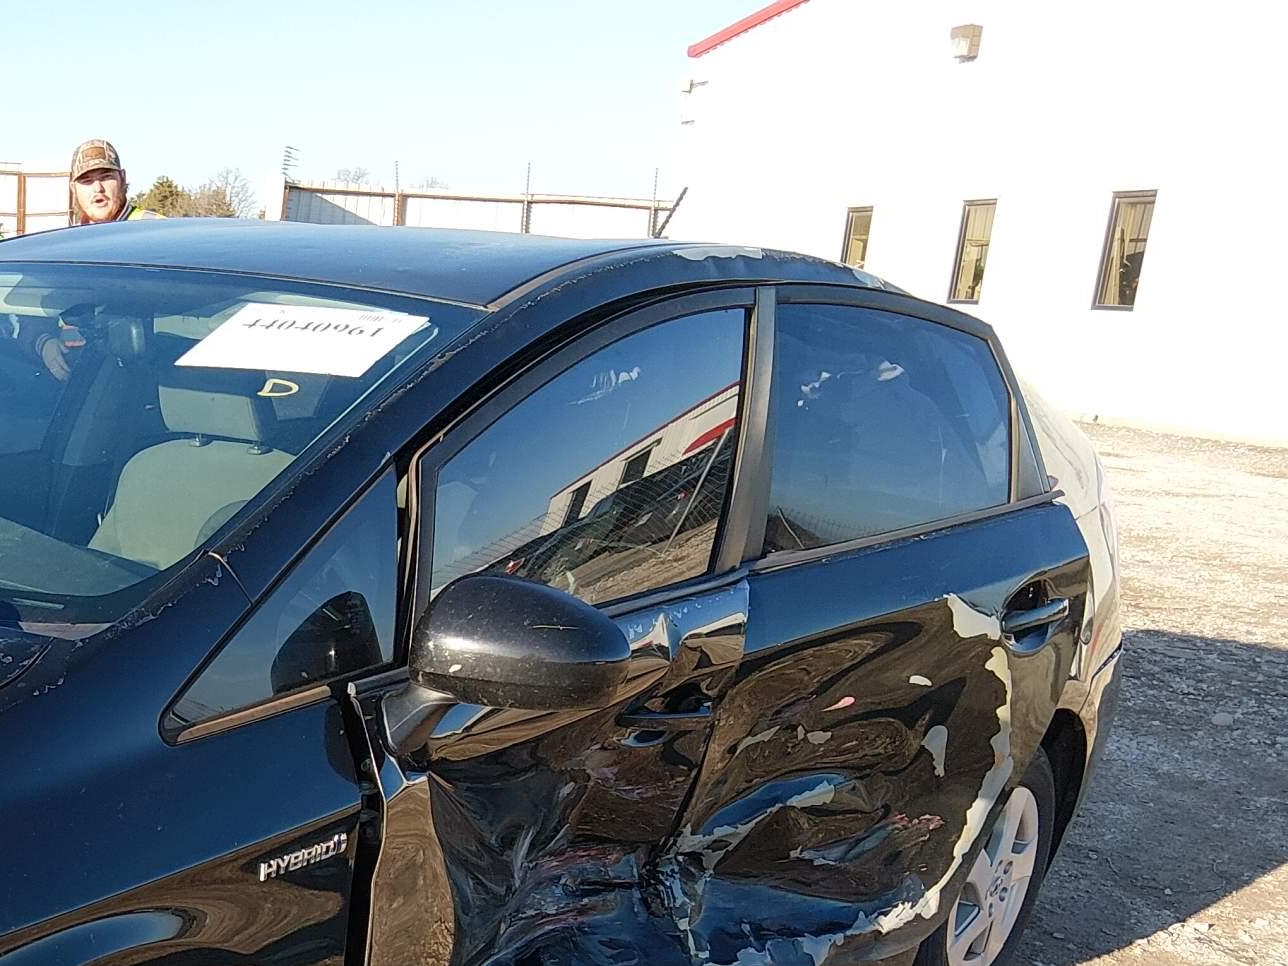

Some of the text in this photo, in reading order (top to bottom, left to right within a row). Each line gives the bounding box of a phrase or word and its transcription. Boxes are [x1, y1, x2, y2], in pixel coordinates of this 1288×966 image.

[242, 318, 385, 337] 44040961
[257, 379, 300, 396] D
[259, 839, 338, 881] HYBRID
